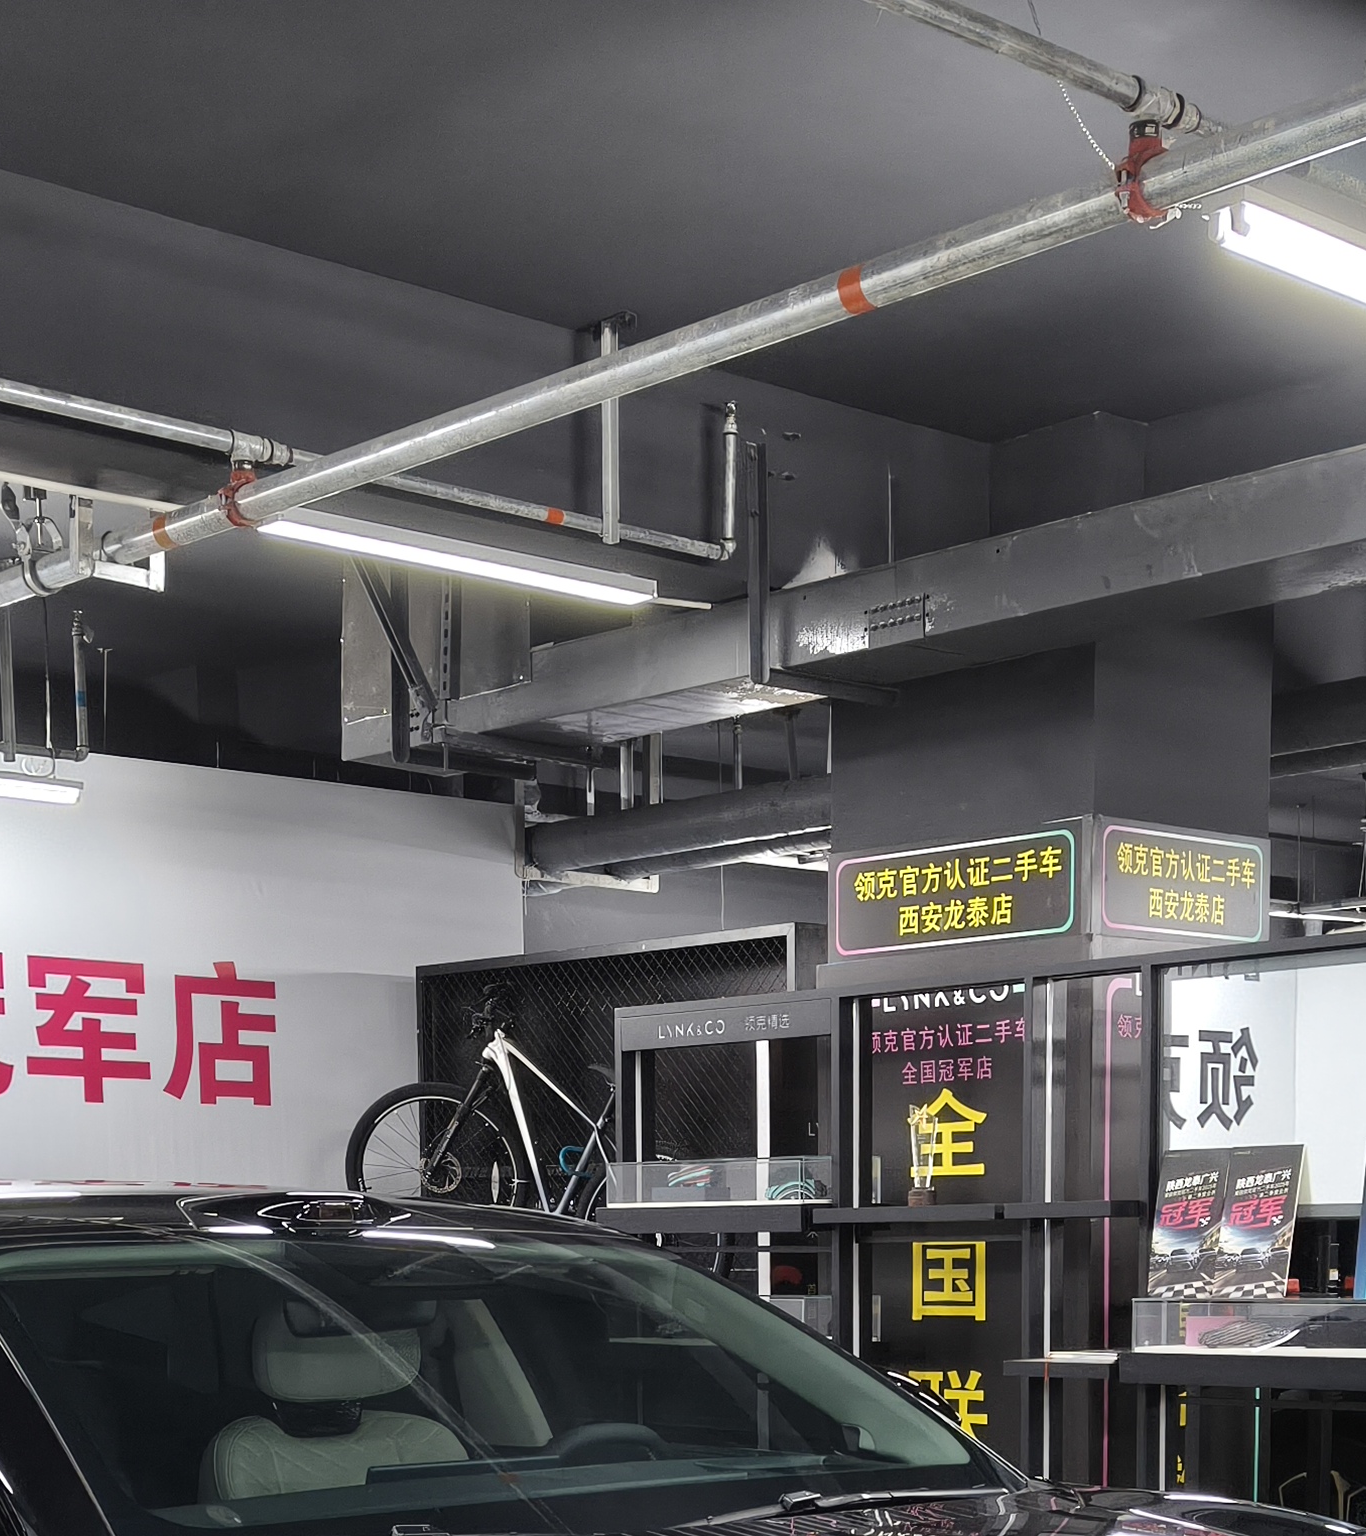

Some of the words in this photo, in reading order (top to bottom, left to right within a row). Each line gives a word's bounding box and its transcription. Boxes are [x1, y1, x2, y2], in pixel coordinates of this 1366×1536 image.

[854, 845, 1063, 902] 领克官方认证二手车
[1117, 842, 1256, 889] 领克官方认证二手车
[899, 893, 1013, 936] 西安龙泰店
[1149, 887, 1225, 925] 西安龙泰店
[658, 1020, 726, 1039] LYNK&CO
[902, 1056, 992, 1085] 全国冠军店
